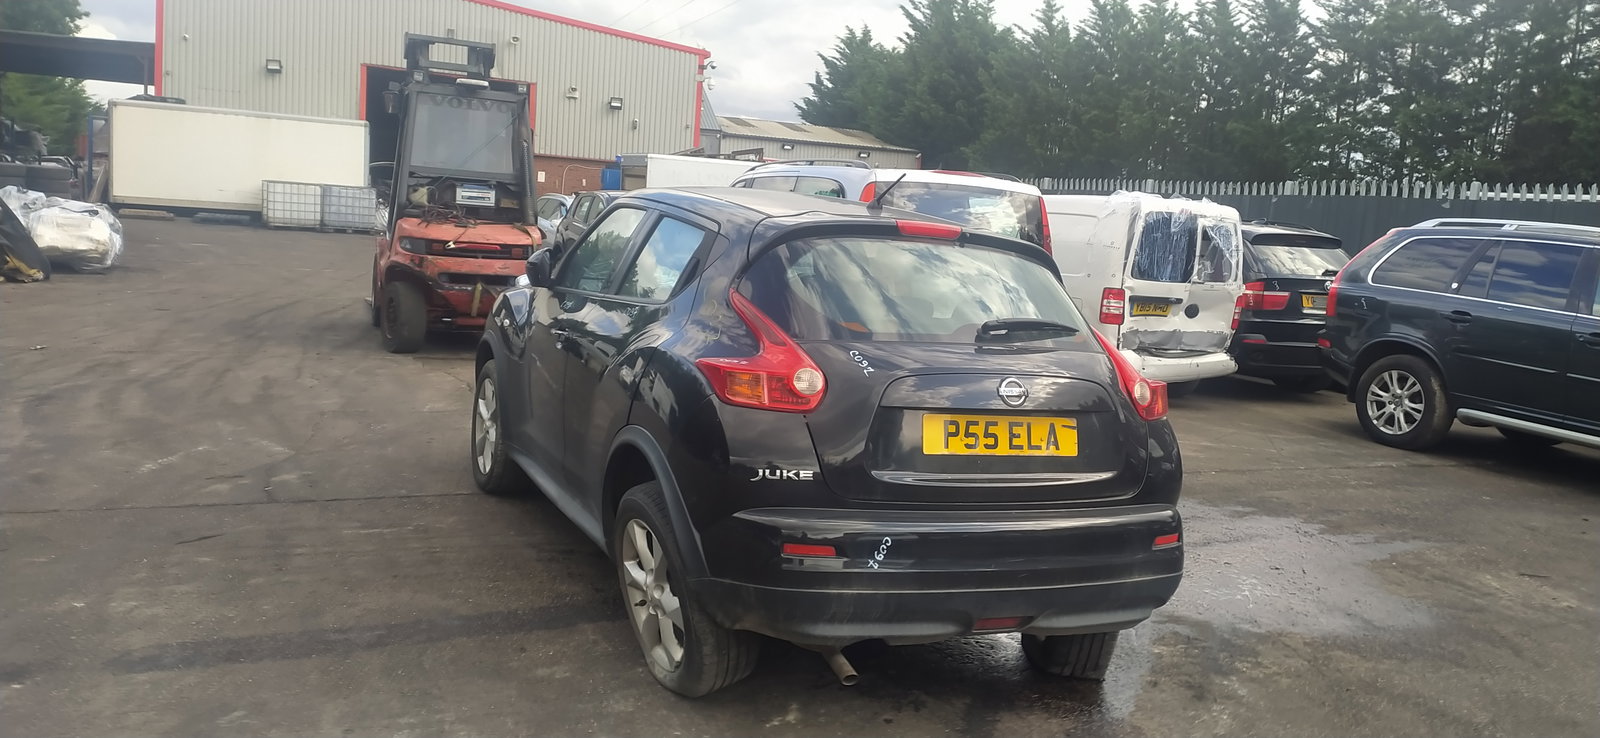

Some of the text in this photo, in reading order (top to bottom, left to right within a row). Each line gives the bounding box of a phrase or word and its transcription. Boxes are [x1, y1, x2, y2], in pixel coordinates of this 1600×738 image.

[431, 95, 510, 114] VOLVO
[943, 419, 1060, 451] P55 ELA
[749, 468, 814, 481] JUKE
